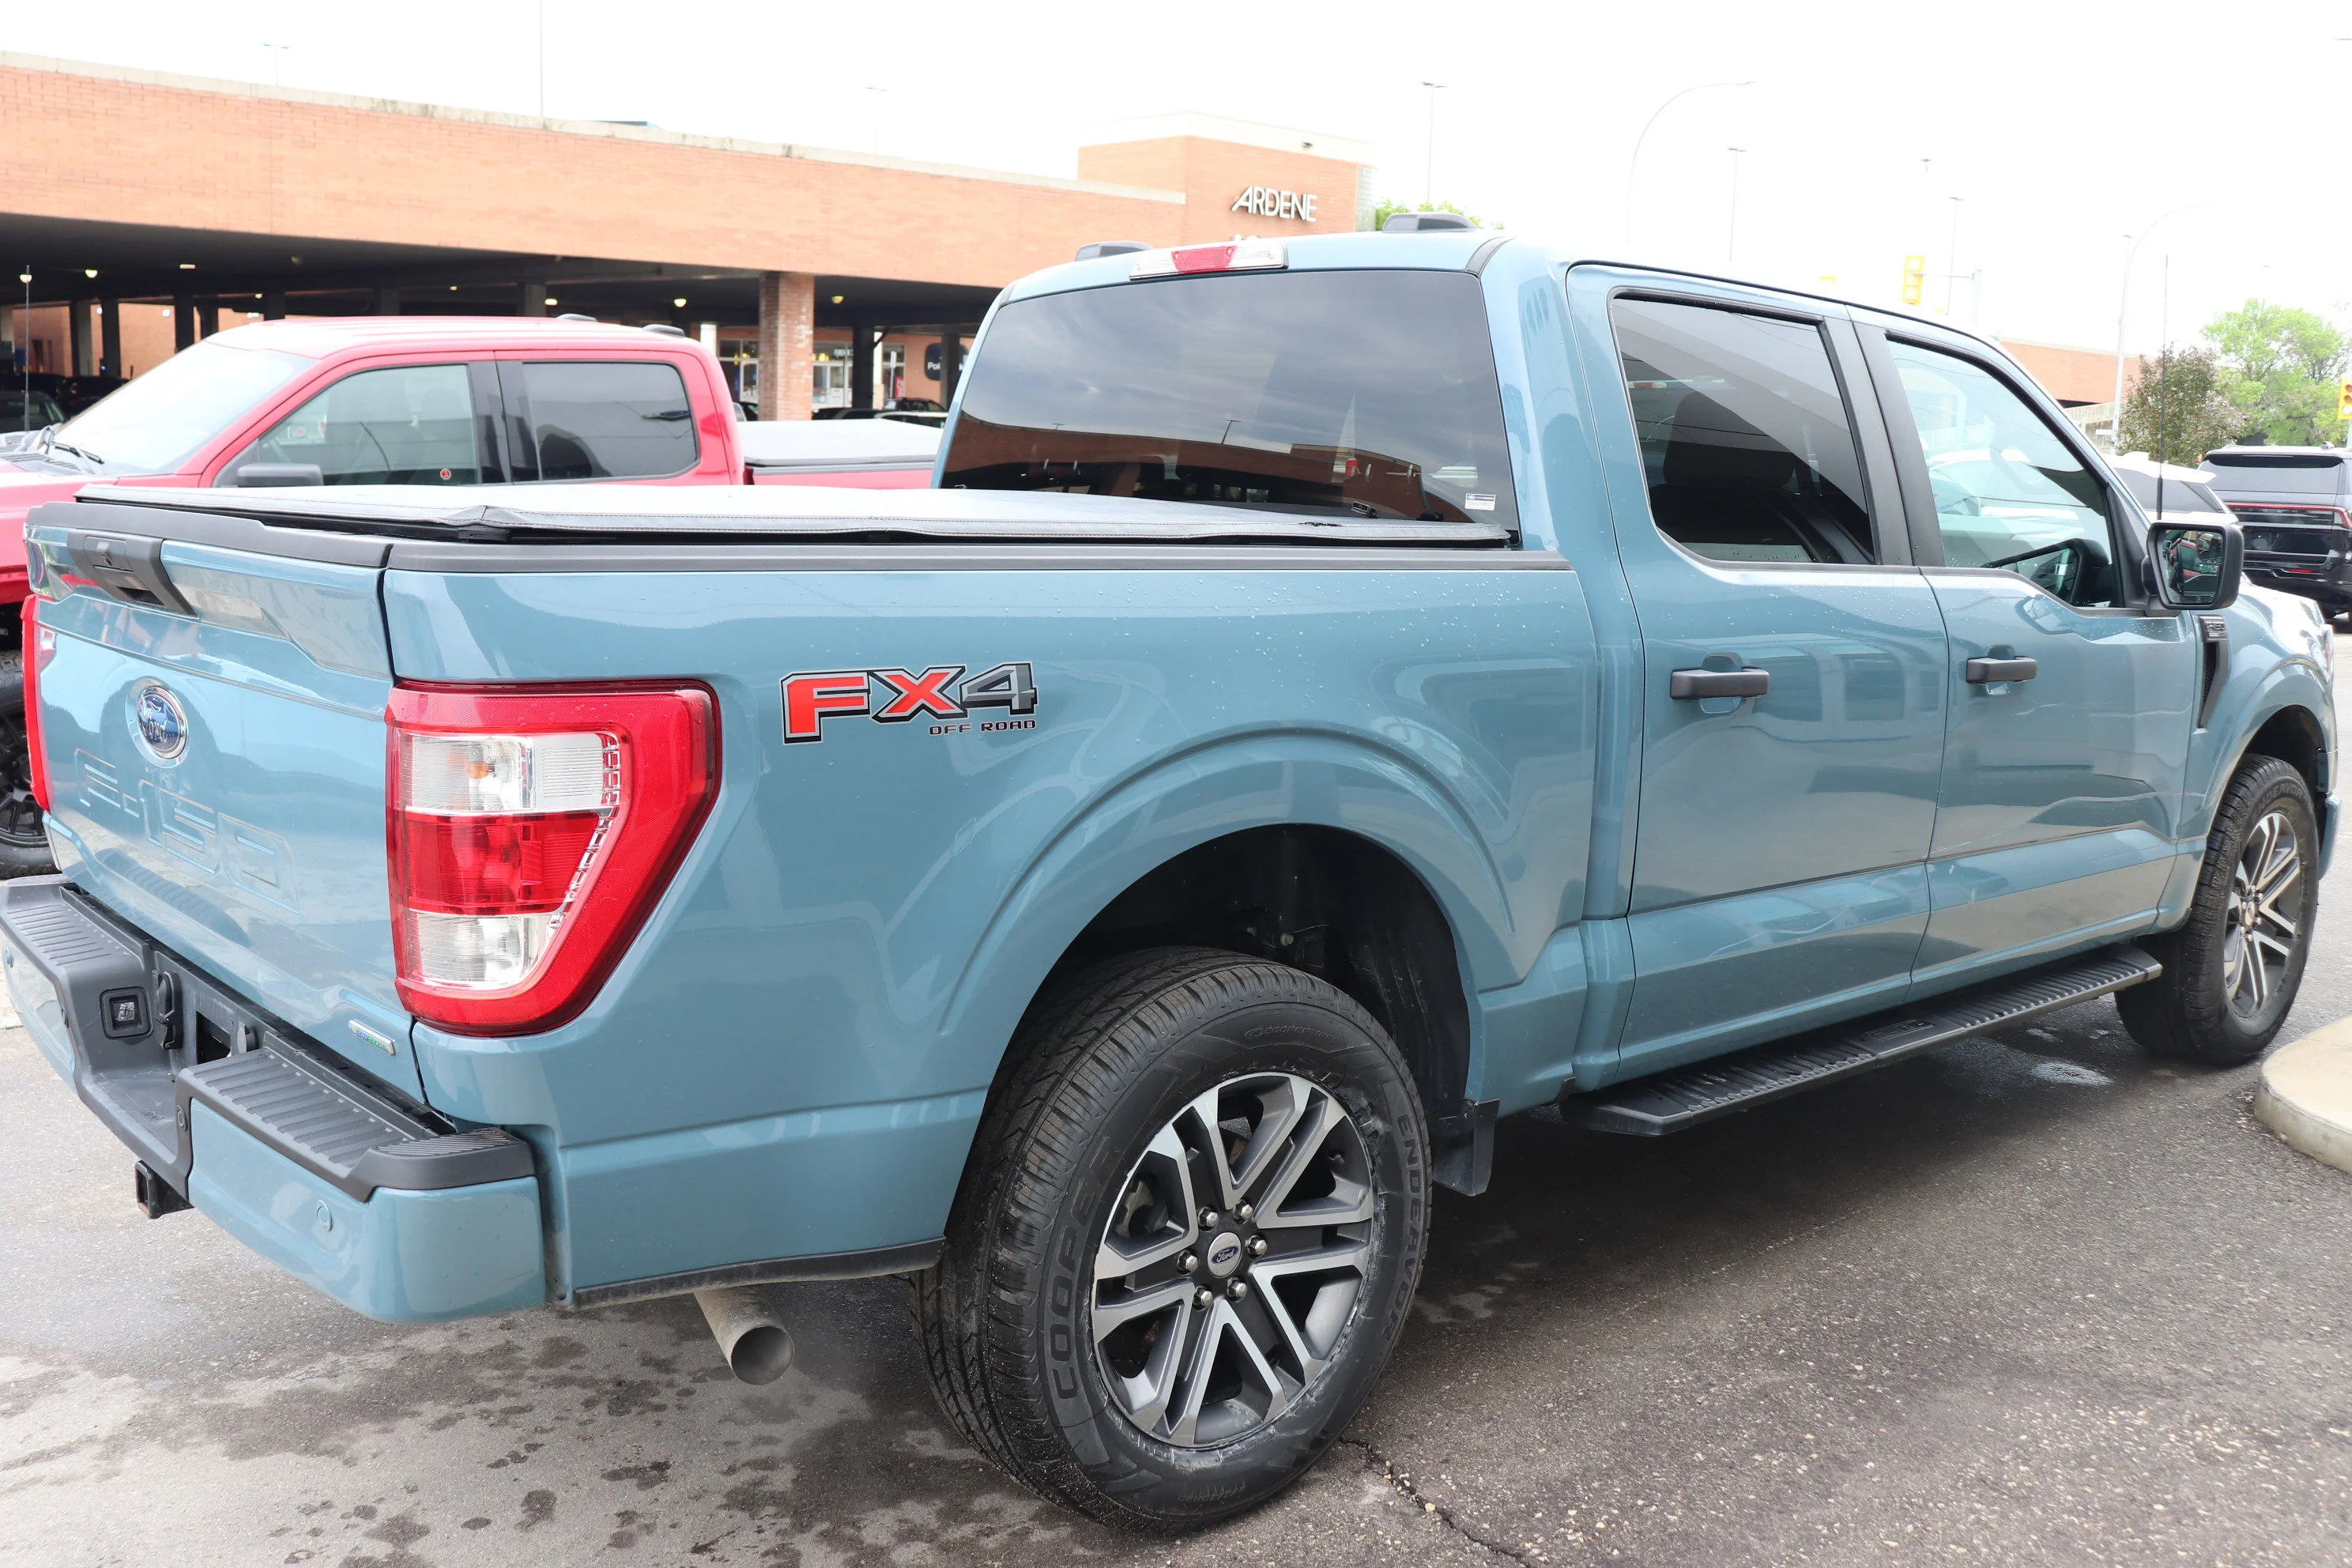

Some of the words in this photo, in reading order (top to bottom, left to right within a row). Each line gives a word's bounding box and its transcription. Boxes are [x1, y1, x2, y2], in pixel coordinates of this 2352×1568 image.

[1231, 186, 1317, 222] ARDENE
[927, 361, 941, 371] Pol
[779, 662, 1038, 745] FX4
[929, 722, 972, 736] OFF
[981, 719, 1036, 733] ROAD
[1384, 1113, 1423, 1342] ENDEAVOR
[1048, 1136, 1119, 1400] COOPER
[1216, 1248, 1235, 1263] Ford
